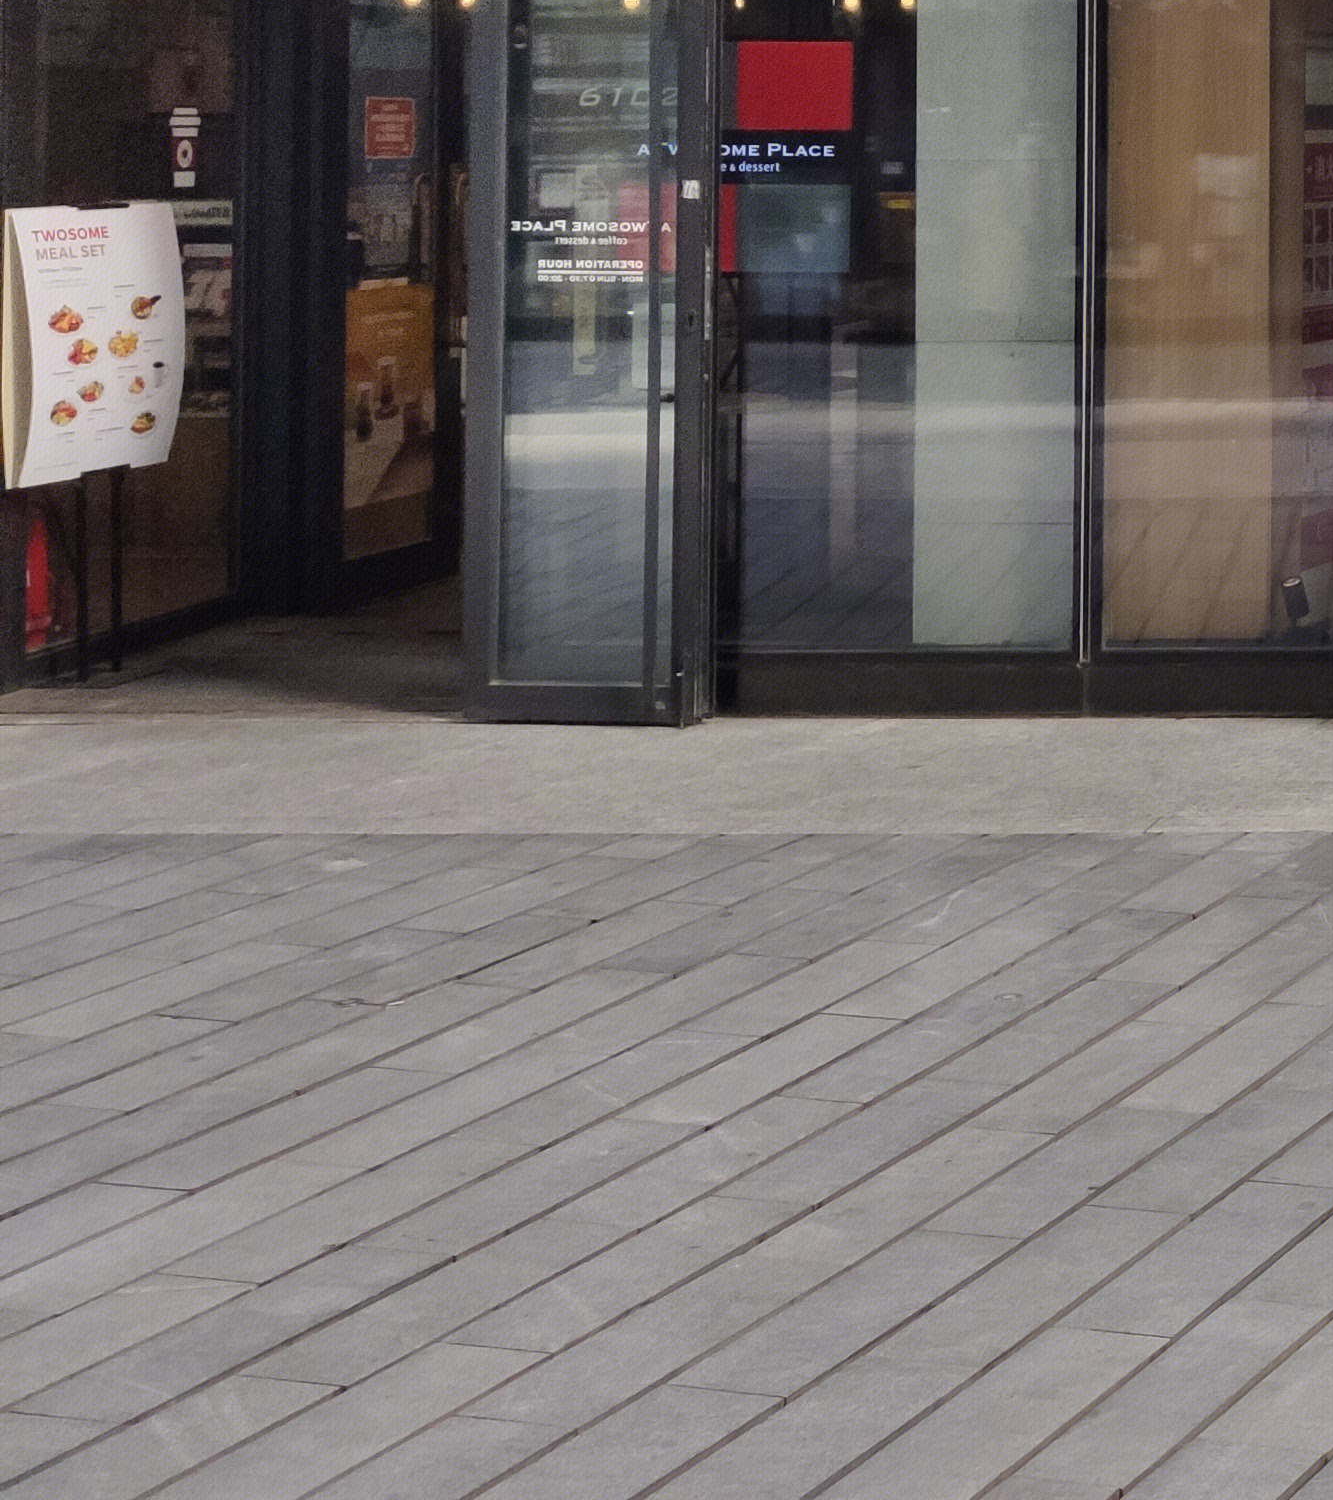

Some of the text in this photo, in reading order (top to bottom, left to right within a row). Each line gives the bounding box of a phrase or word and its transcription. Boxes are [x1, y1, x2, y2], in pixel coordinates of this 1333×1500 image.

[767, 143, 835, 157] PLACE
[739, 161, 780, 172] dessert
[31, 226, 110, 243] TWOSOME
[35, 244, 107, 261] MEAL SET
